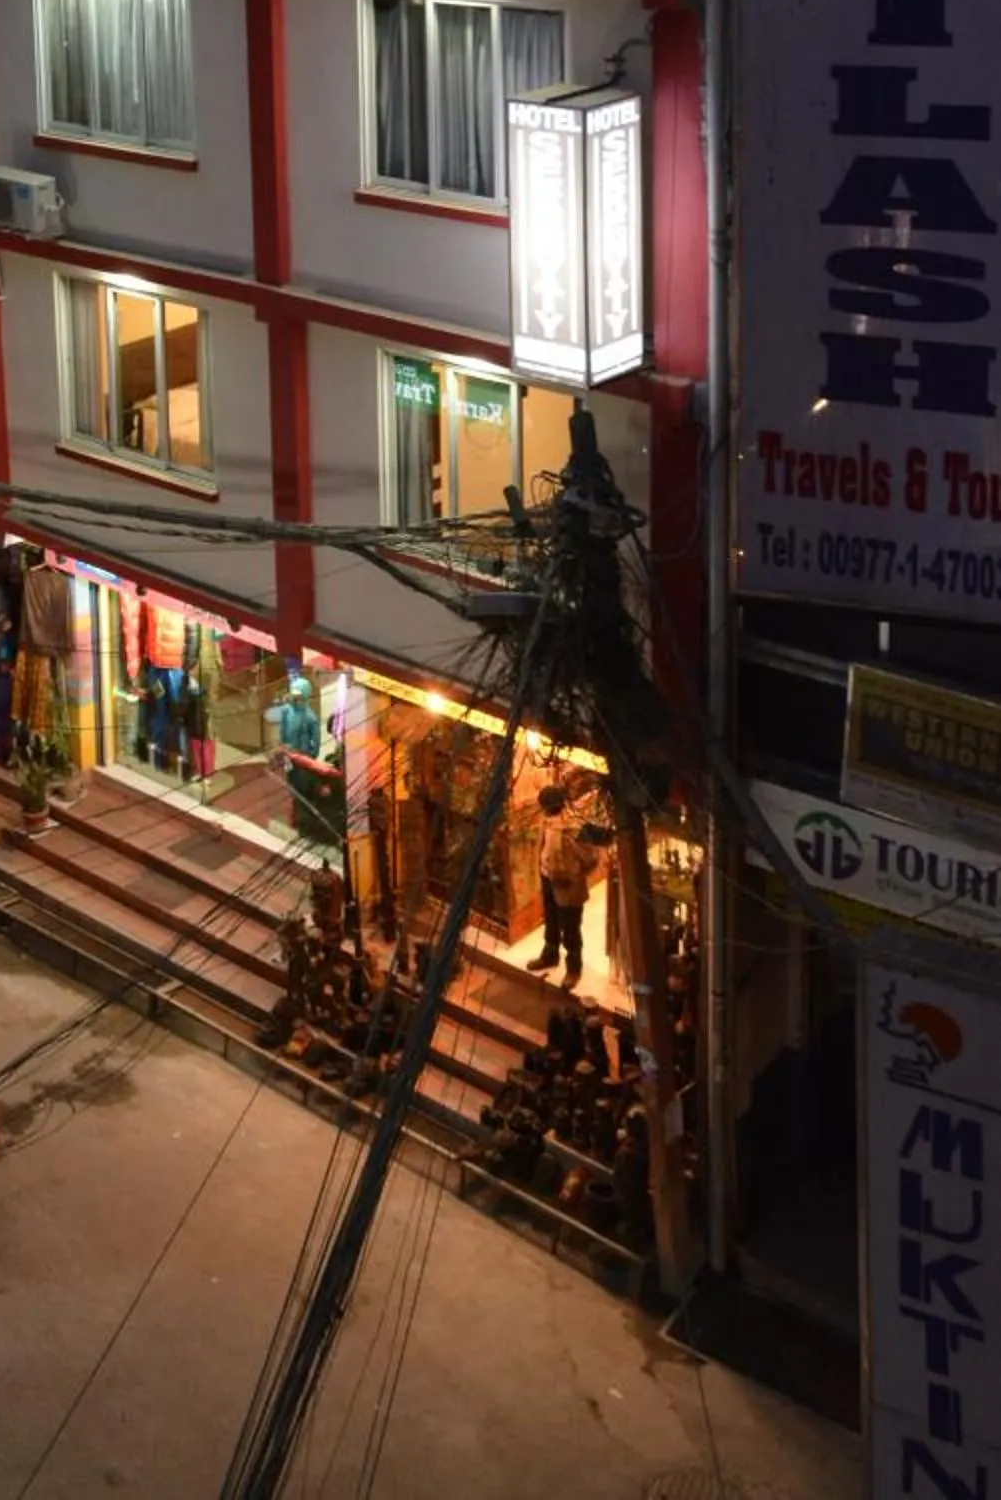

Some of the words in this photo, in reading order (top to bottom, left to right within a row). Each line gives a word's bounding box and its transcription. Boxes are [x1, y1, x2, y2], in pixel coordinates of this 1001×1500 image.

[509, 102, 582, 133] HOTEL
[587, 101, 640, 135] HOTEL
[756, 429, 893, 510] Travels
[904, 446, 928, 514] &
[757, 522, 796, 569] Tel
[816, 528, 1001, 599] 00977-1-4700
[904, 728, 999, 775] UNION
